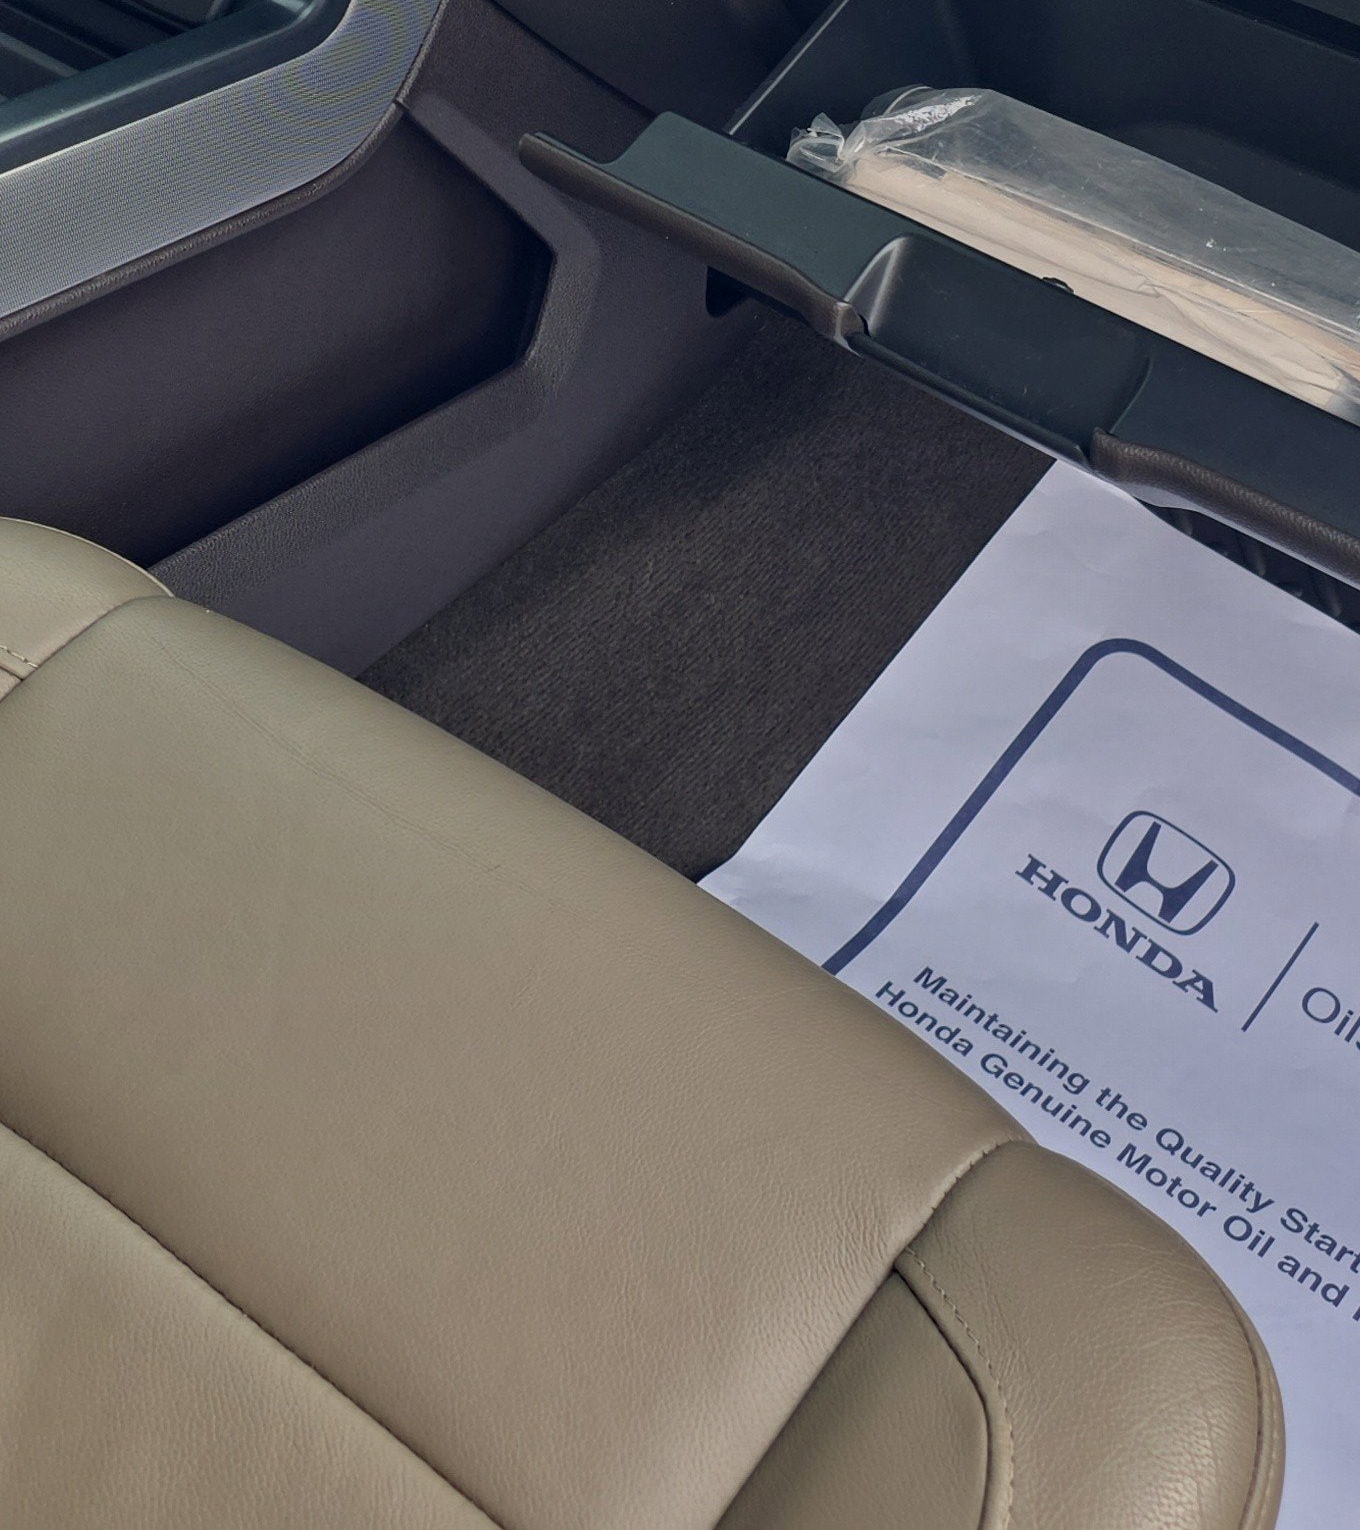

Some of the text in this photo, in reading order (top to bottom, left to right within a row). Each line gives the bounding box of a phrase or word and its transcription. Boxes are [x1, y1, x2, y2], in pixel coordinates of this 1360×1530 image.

[1014, 853, 1219, 1013] HONDA
[874, 981, 974, 1057] Honda
[979, 1053, 1112, 1148] Genuine
[1116, 1142, 1217, 1218] Motor
[1222, 1214, 1276, 1258] Oil
[1276, 1254, 1350, 1308] and
[913, 966, 1091, 1095] Maintaining
[1094, 1086, 1149, 1131] the
[1155, 1126, 1276, 1214] Quality
